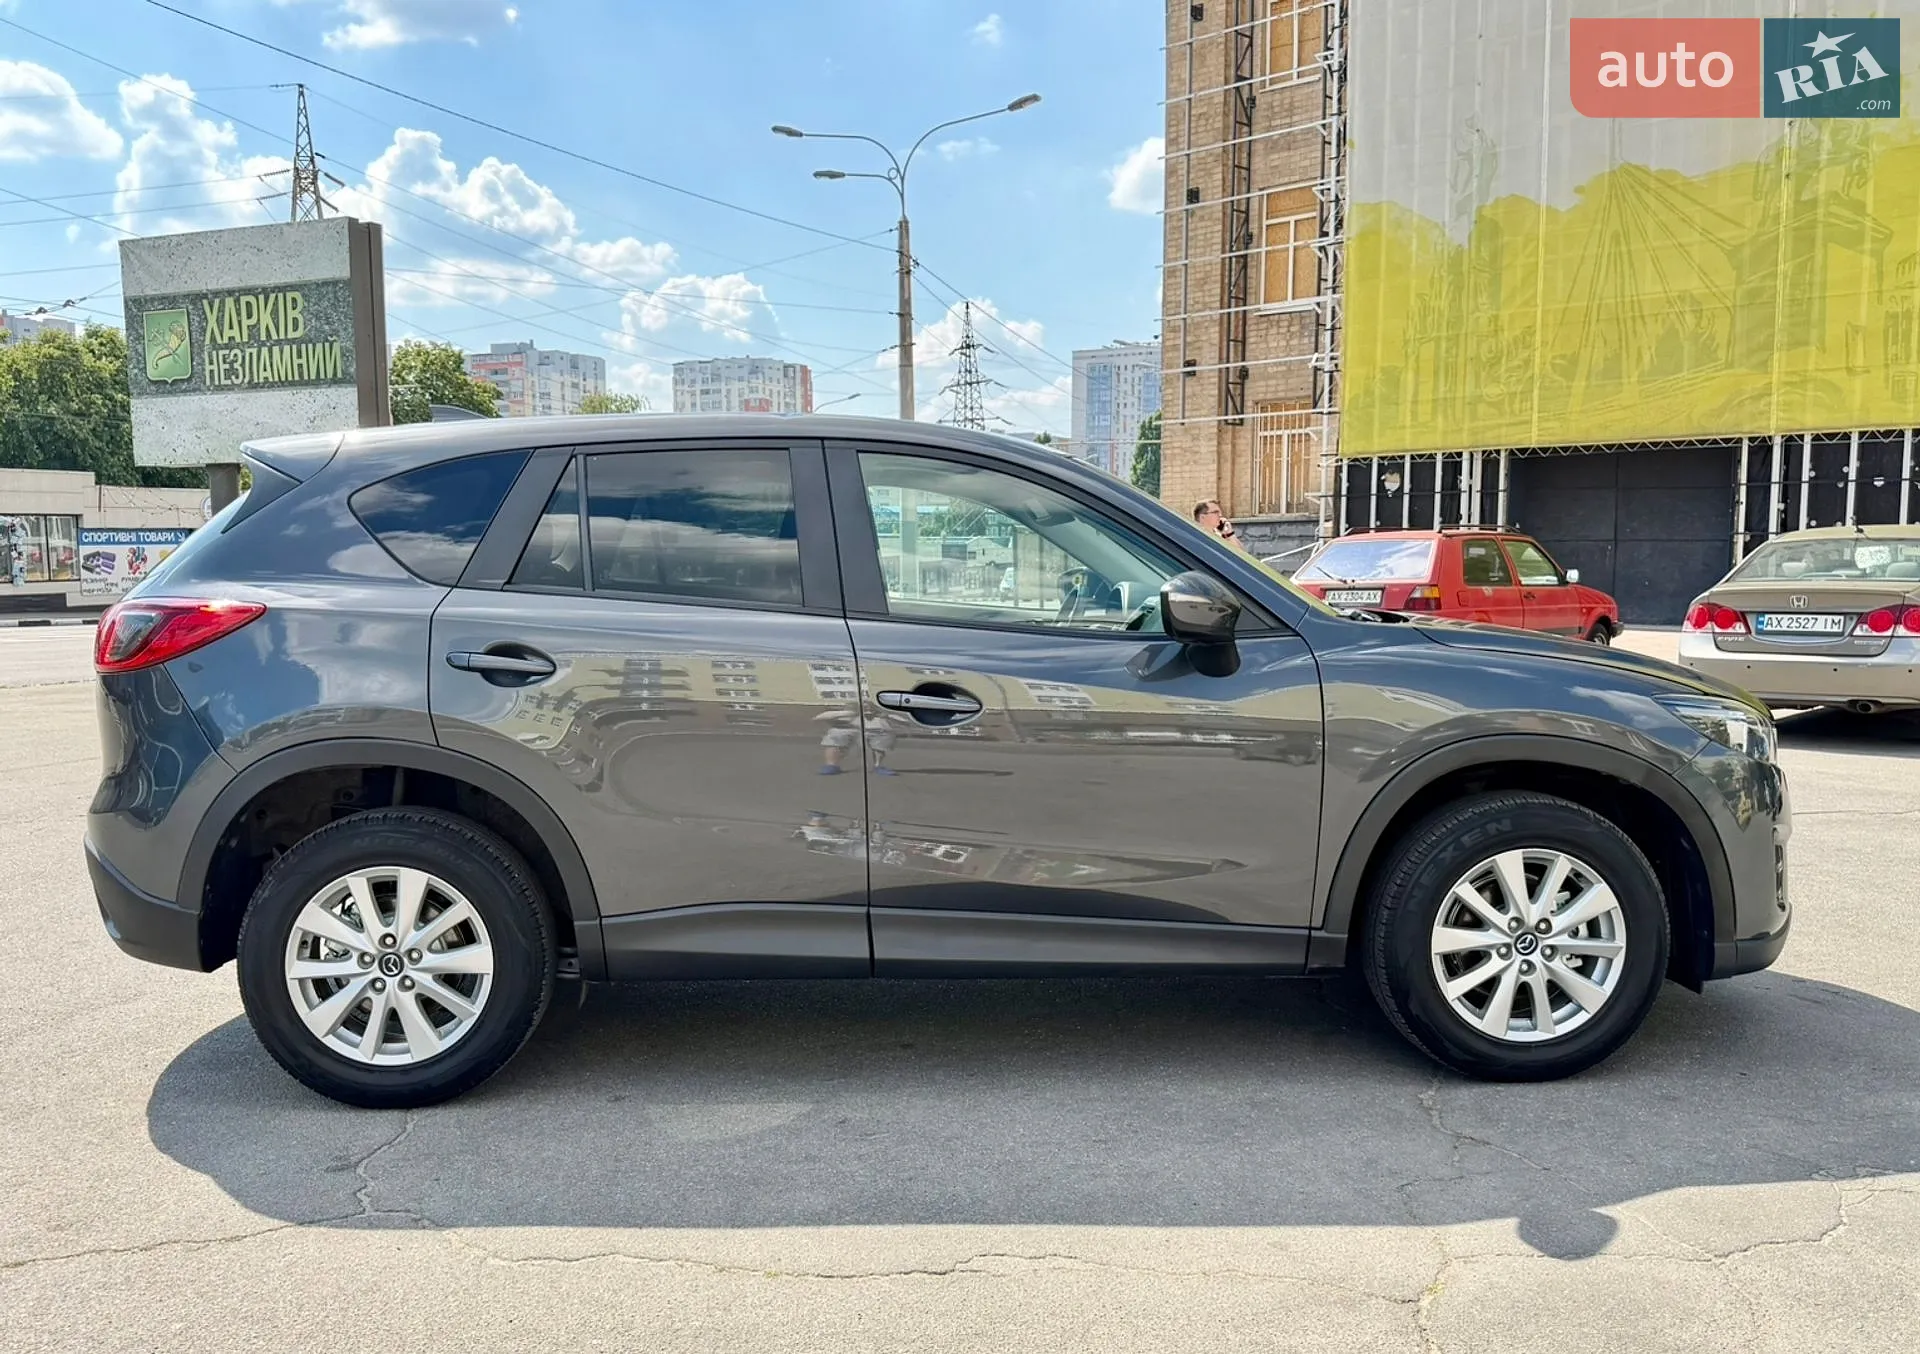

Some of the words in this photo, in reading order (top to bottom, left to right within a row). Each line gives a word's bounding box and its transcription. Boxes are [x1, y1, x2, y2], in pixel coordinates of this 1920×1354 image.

[203, 291, 305, 345] ХАРКІВ
[205, 335, 343, 386] НЕЗЛАМНИЙ
[82, 531, 137, 542] СПОРТИВНІ
[140, 531, 175, 541] ТОВАРИ
[1331, 591, 1343, 601] AX
[1365, 591, 1379, 601] AX
[1765, 616, 1783, 629] AX
[1786, 615, 1818, 629] 2527
[1406, 818, 1513, 913] NEXEN
